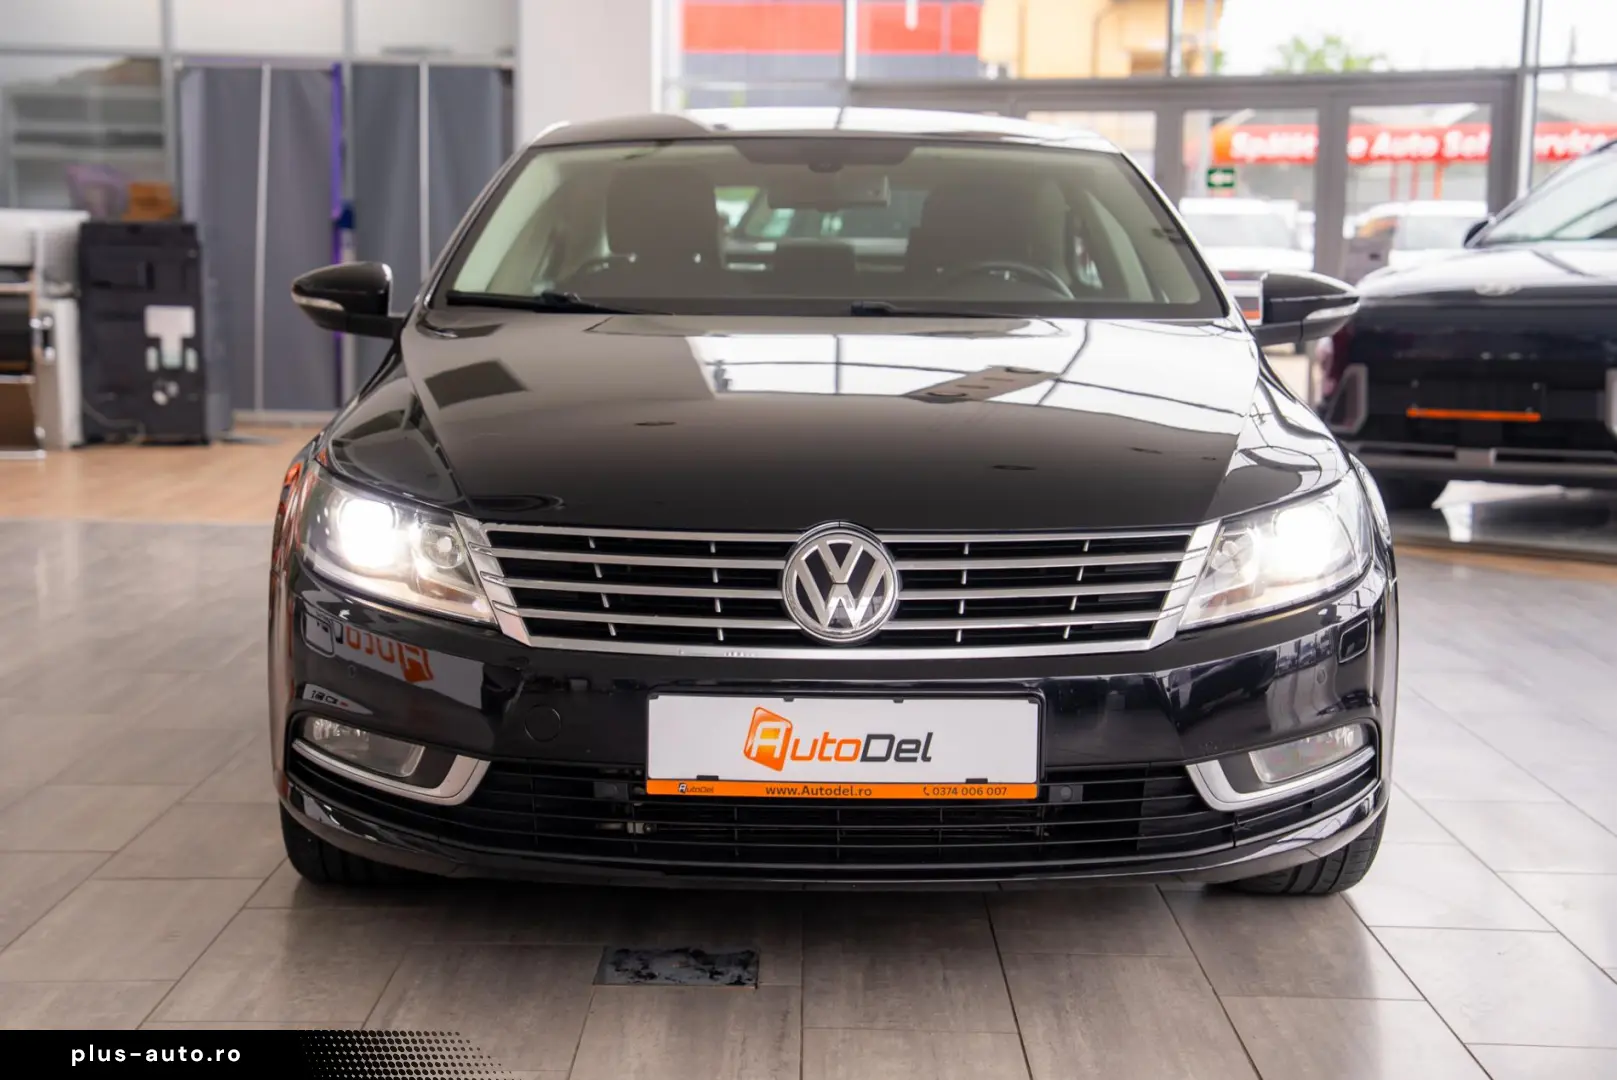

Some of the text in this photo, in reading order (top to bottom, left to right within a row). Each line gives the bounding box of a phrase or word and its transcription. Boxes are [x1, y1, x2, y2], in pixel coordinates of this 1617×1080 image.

[747, 716, 934, 765] AutoDel
[678, 782, 714, 794] AutoDel
[765, 784, 873, 798] www.Autodel.ro
[932, 786, 1007, 797] 0374 006 007
